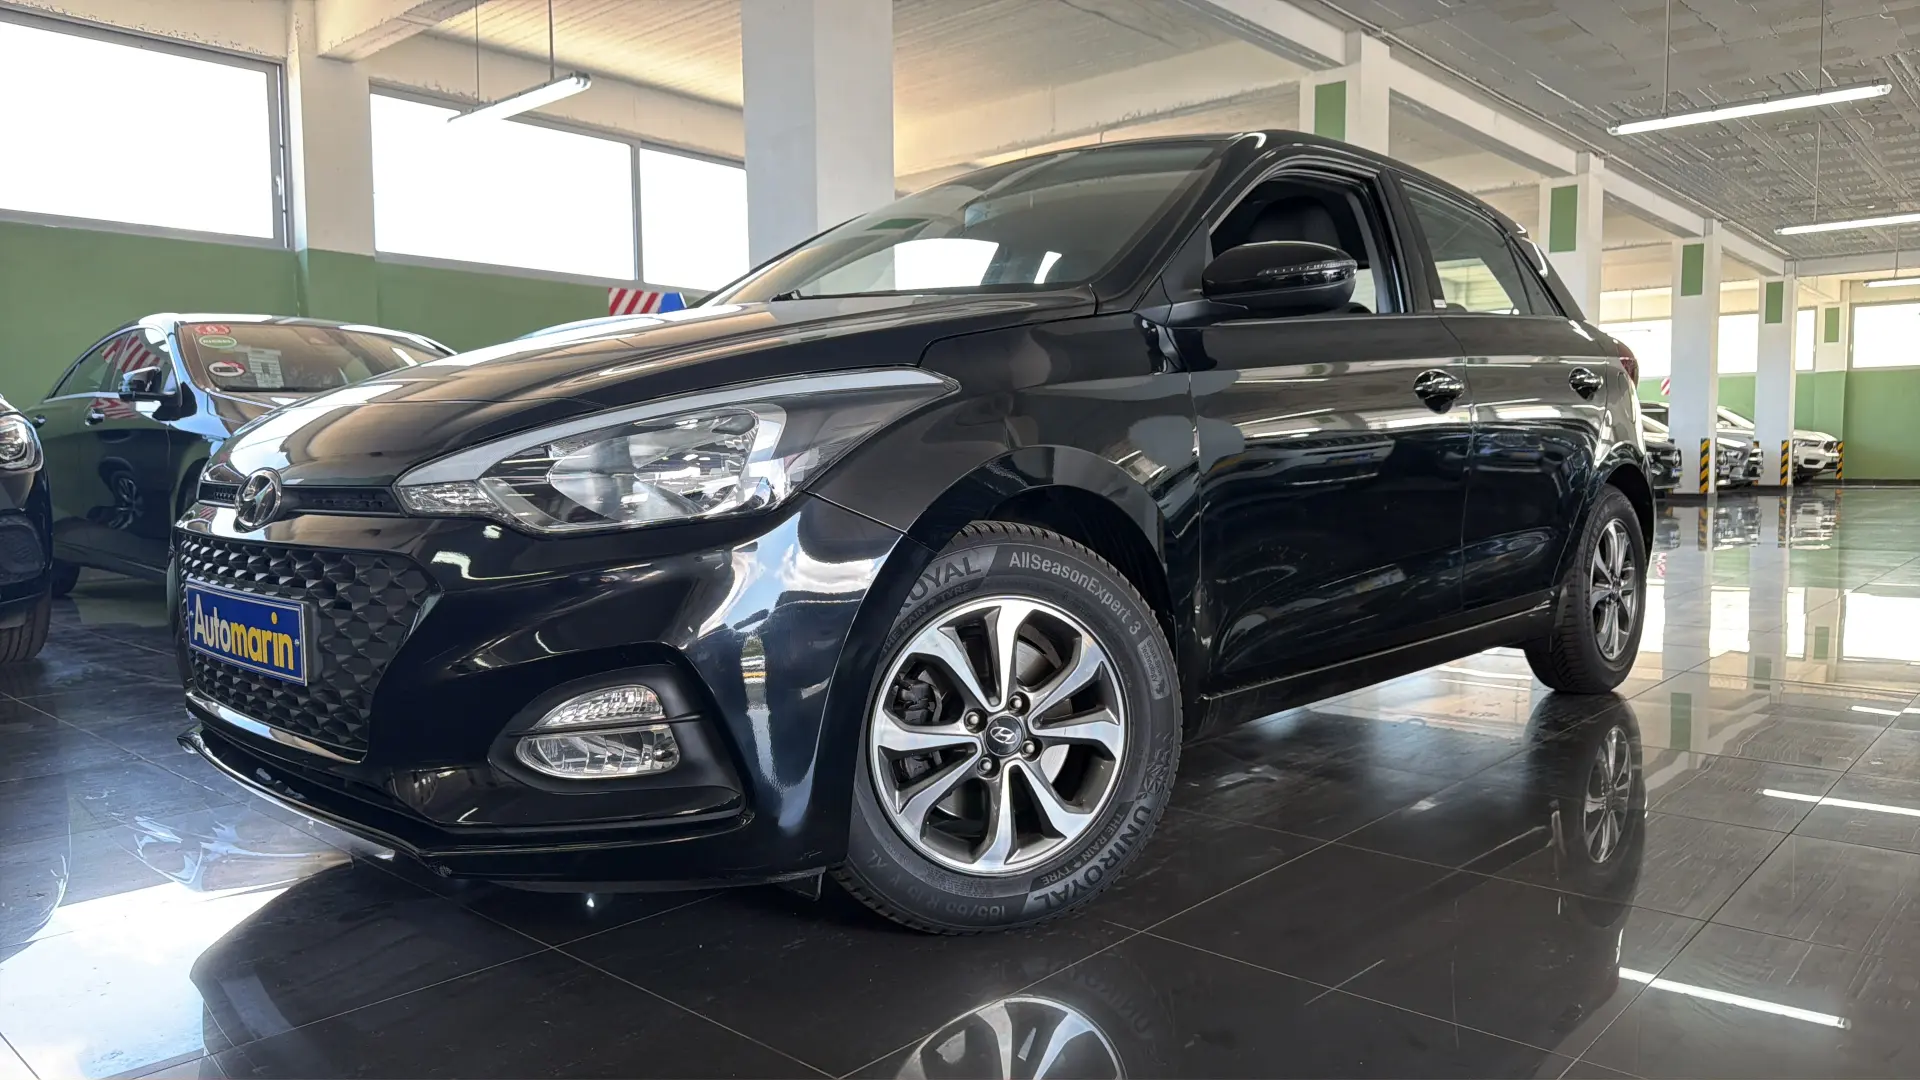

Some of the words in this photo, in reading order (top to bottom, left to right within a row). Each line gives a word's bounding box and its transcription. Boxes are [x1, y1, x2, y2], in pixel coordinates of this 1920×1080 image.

[899, 605, 928, 632] RAIN
[940, 583, 970, 602] TYRE
[1008, 551, 1132, 623] AllSeasonExpert
[1128, 620, 1142, 635] 3
[194, 593, 294, 671] Automarin
[1082, 836, 1108, 861] RAIN
[1109, 813, 1125, 836] THE
[1033, 805, 1152, 908] UNIROYAL
[1041, 867, 1074, 885] TYRE
